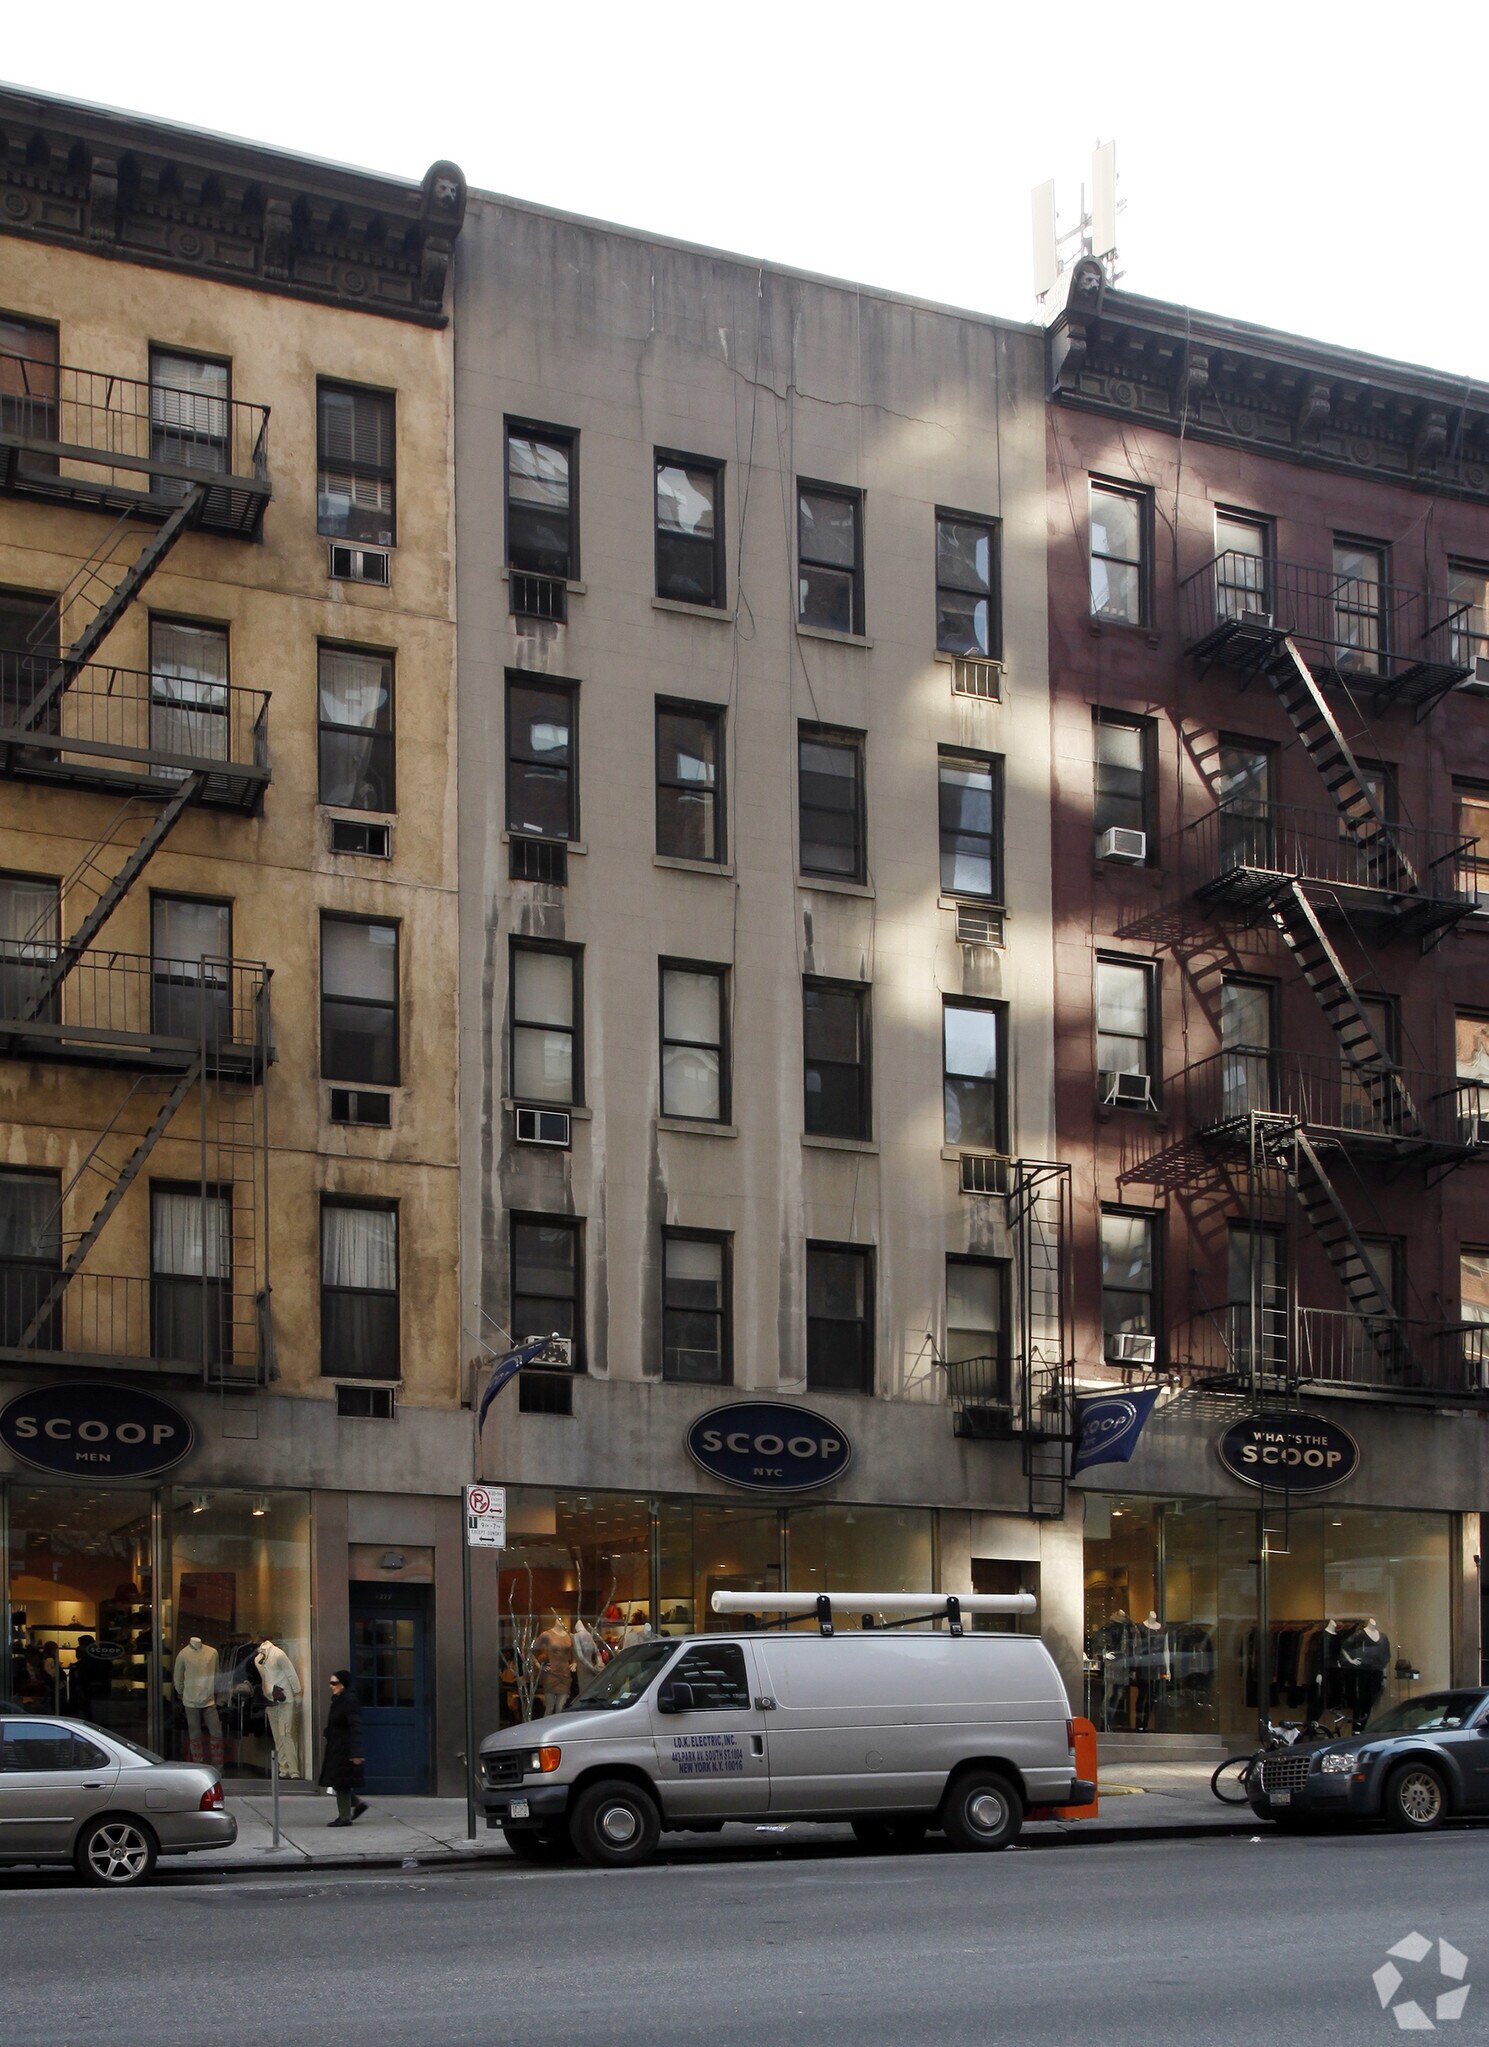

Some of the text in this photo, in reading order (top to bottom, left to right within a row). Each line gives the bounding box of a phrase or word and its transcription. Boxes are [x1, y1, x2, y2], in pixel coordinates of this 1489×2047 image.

[15, 1416, 175, 1445] SCOOP
[702, 1430, 840, 1459] SCOOP
[1304, 1435, 1328, 1446] THE
[76, 1452, 111, 1462] MEN
[1242, 1445, 1341, 1468] SCOOP
[753, 1467, 783, 1477] NYC
[705, 1749, 723, 1760] SOUTH
[679, 1762, 693, 1773] NEW
[695, 1761, 711, 1772] YORK
